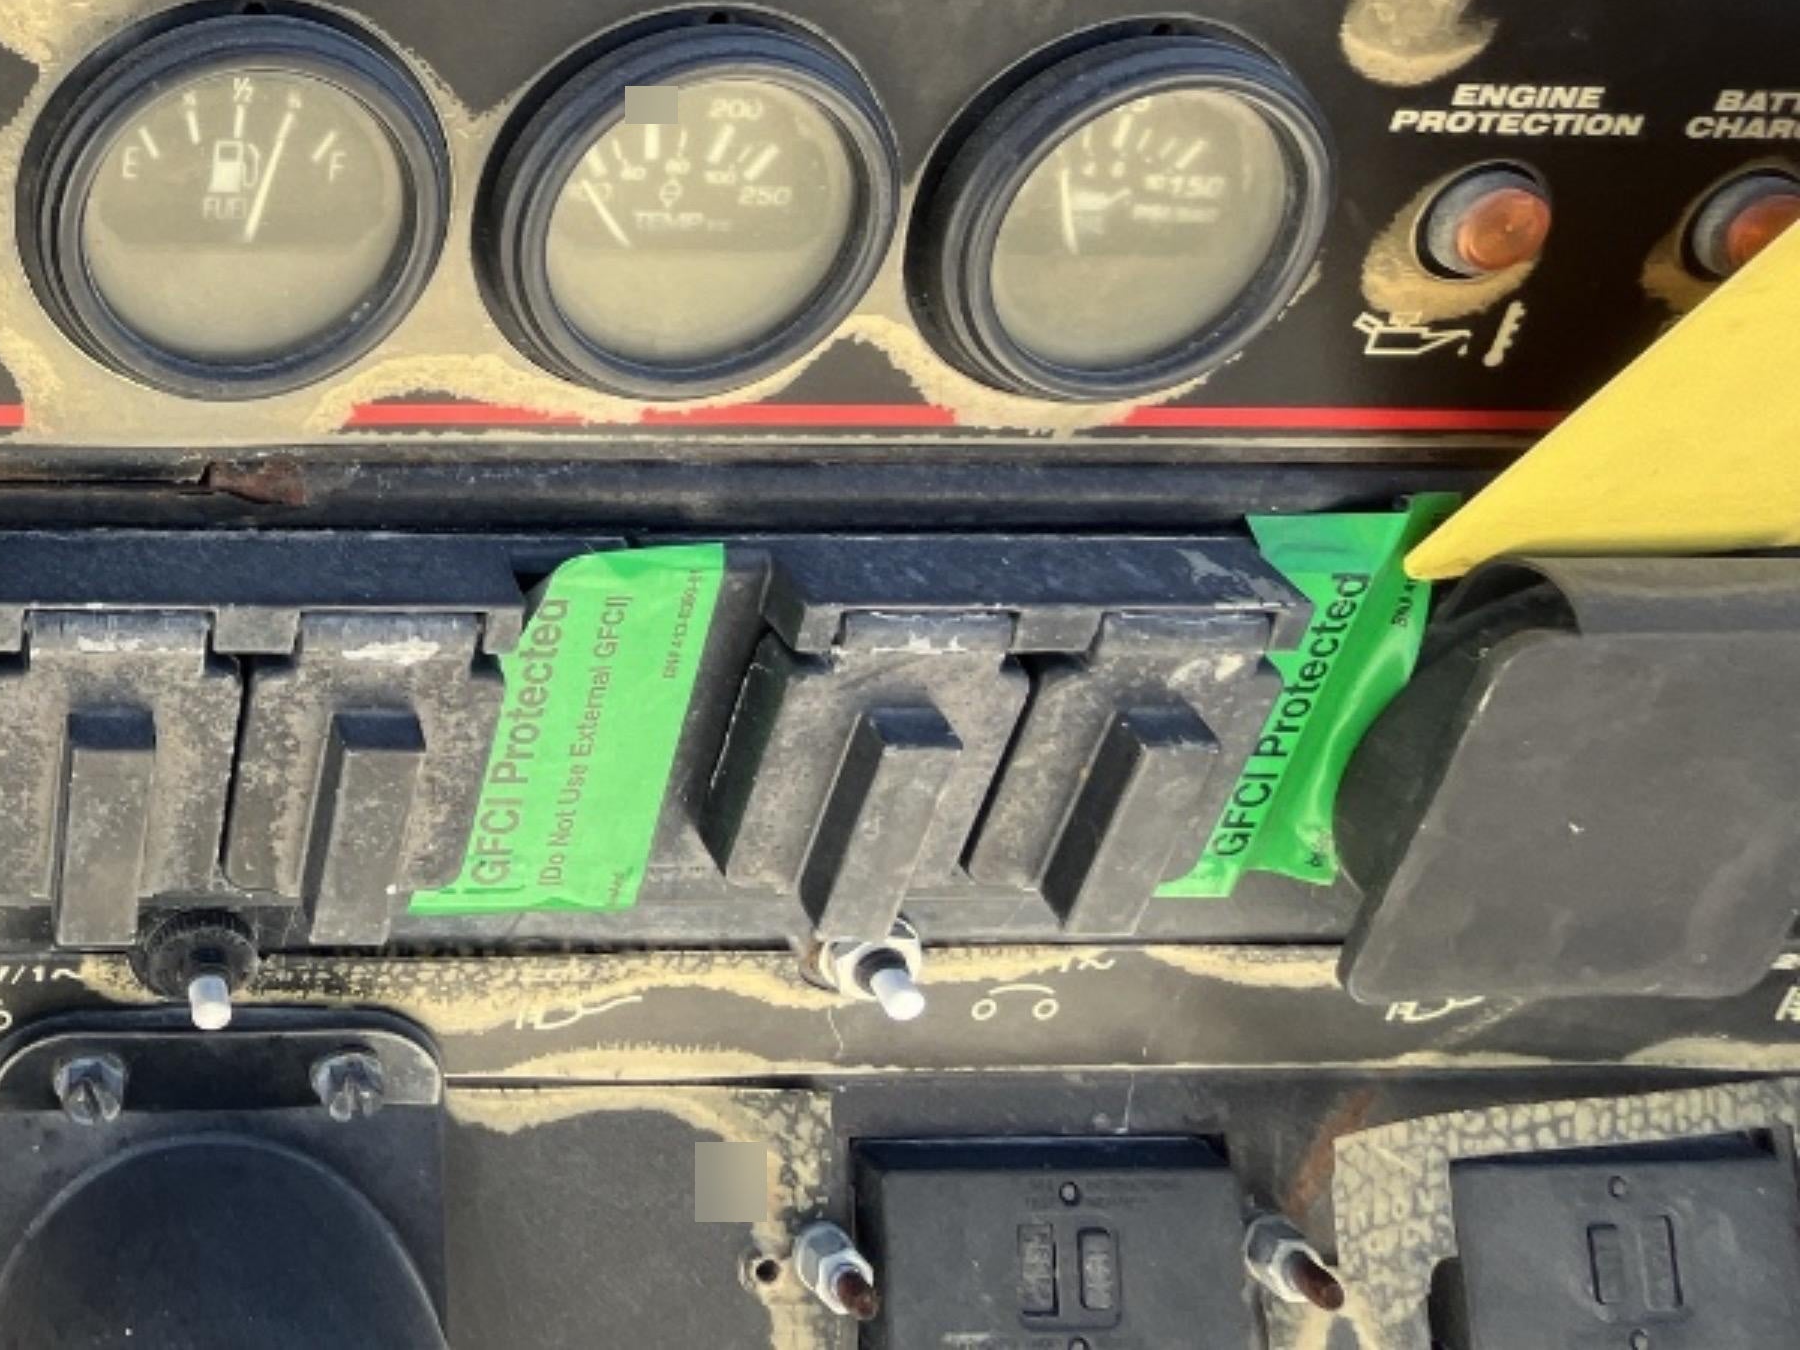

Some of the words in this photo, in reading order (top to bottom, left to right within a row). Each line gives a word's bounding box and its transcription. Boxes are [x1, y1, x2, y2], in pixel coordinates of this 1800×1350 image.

[1450, 83, 1606, 110] ENGINE
[1388, 109, 1645, 137] PROTECTION
[121, 146, 139, 179] E
[328, 150, 347, 183] F
[489, 598, 570, 784] Protected
[569, 664, 613, 757] External
[1211, 772, 1279, 857] GFCI
[1256, 572, 1369, 758] Protected
[556, 764, 590, 805] Use
[470, 797, 524, 886] GFCI
[545, 808, 577, 846] Not
